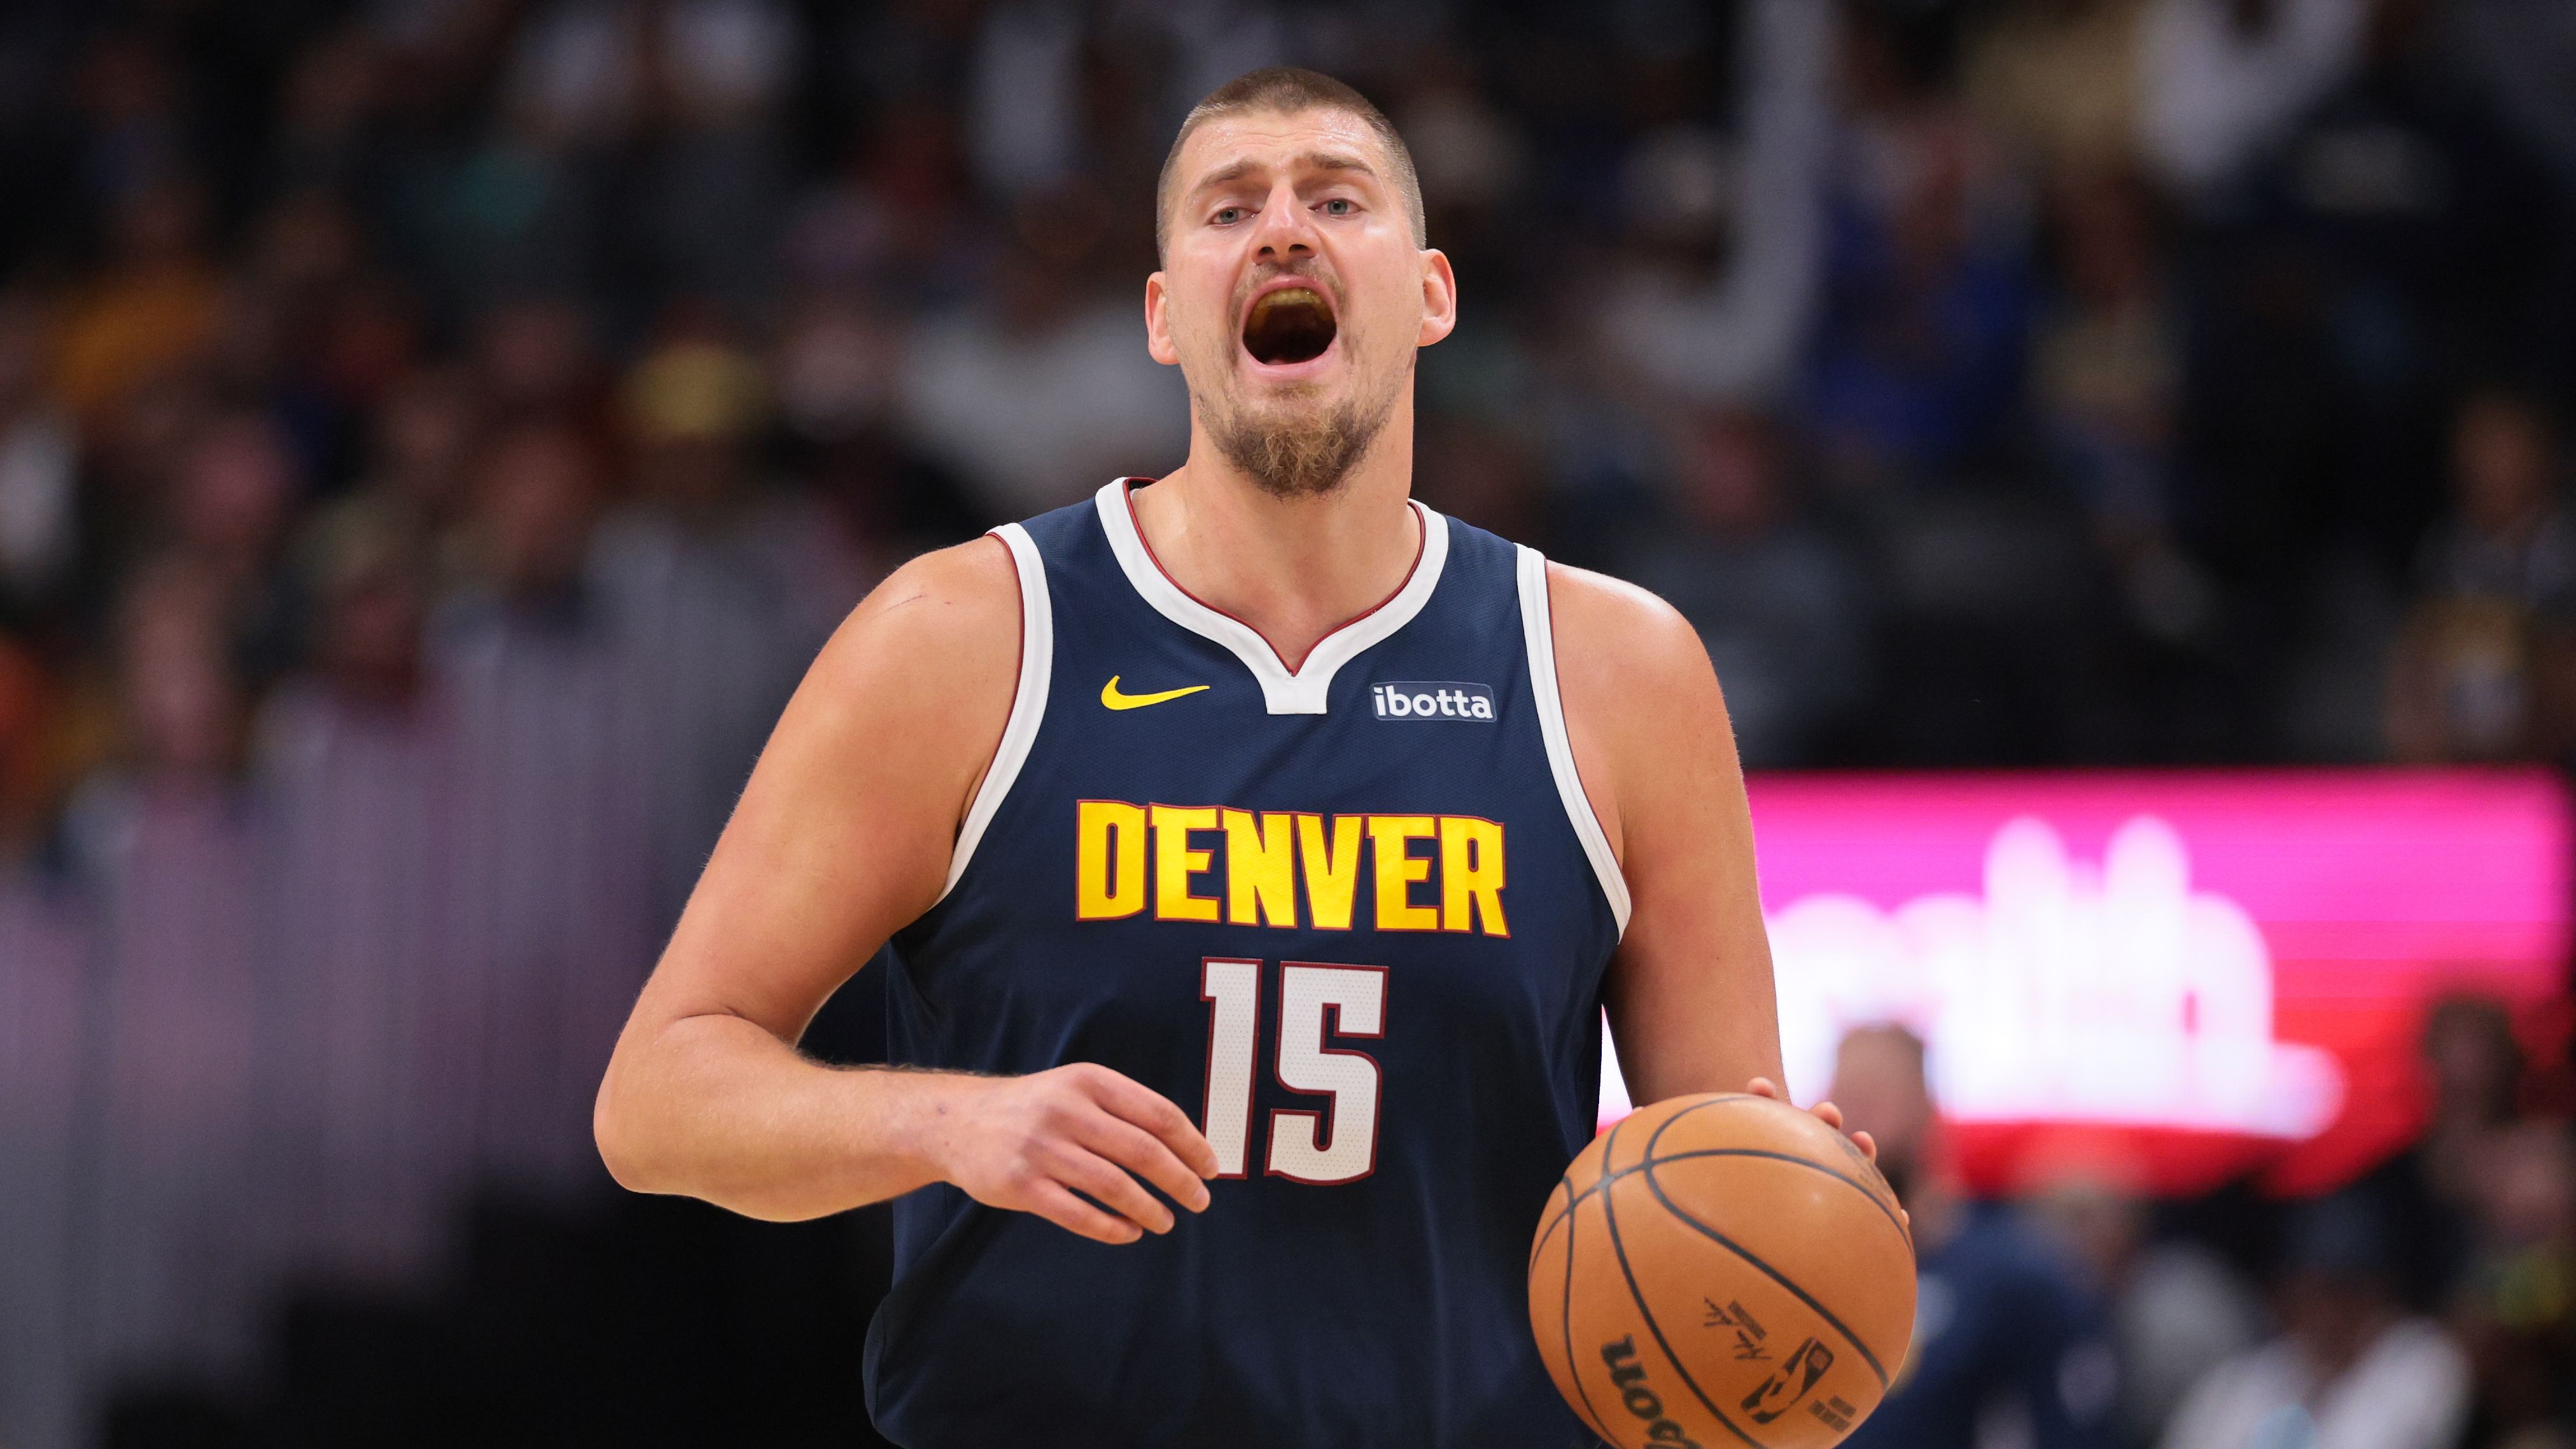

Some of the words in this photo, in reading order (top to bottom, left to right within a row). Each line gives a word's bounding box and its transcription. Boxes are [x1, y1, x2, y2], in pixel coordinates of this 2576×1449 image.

[1373, 685, 1494, 719] ibotta
[1075, 799, 1511, 938] DENVER
[1200, 957, 1389, 1185] 15
